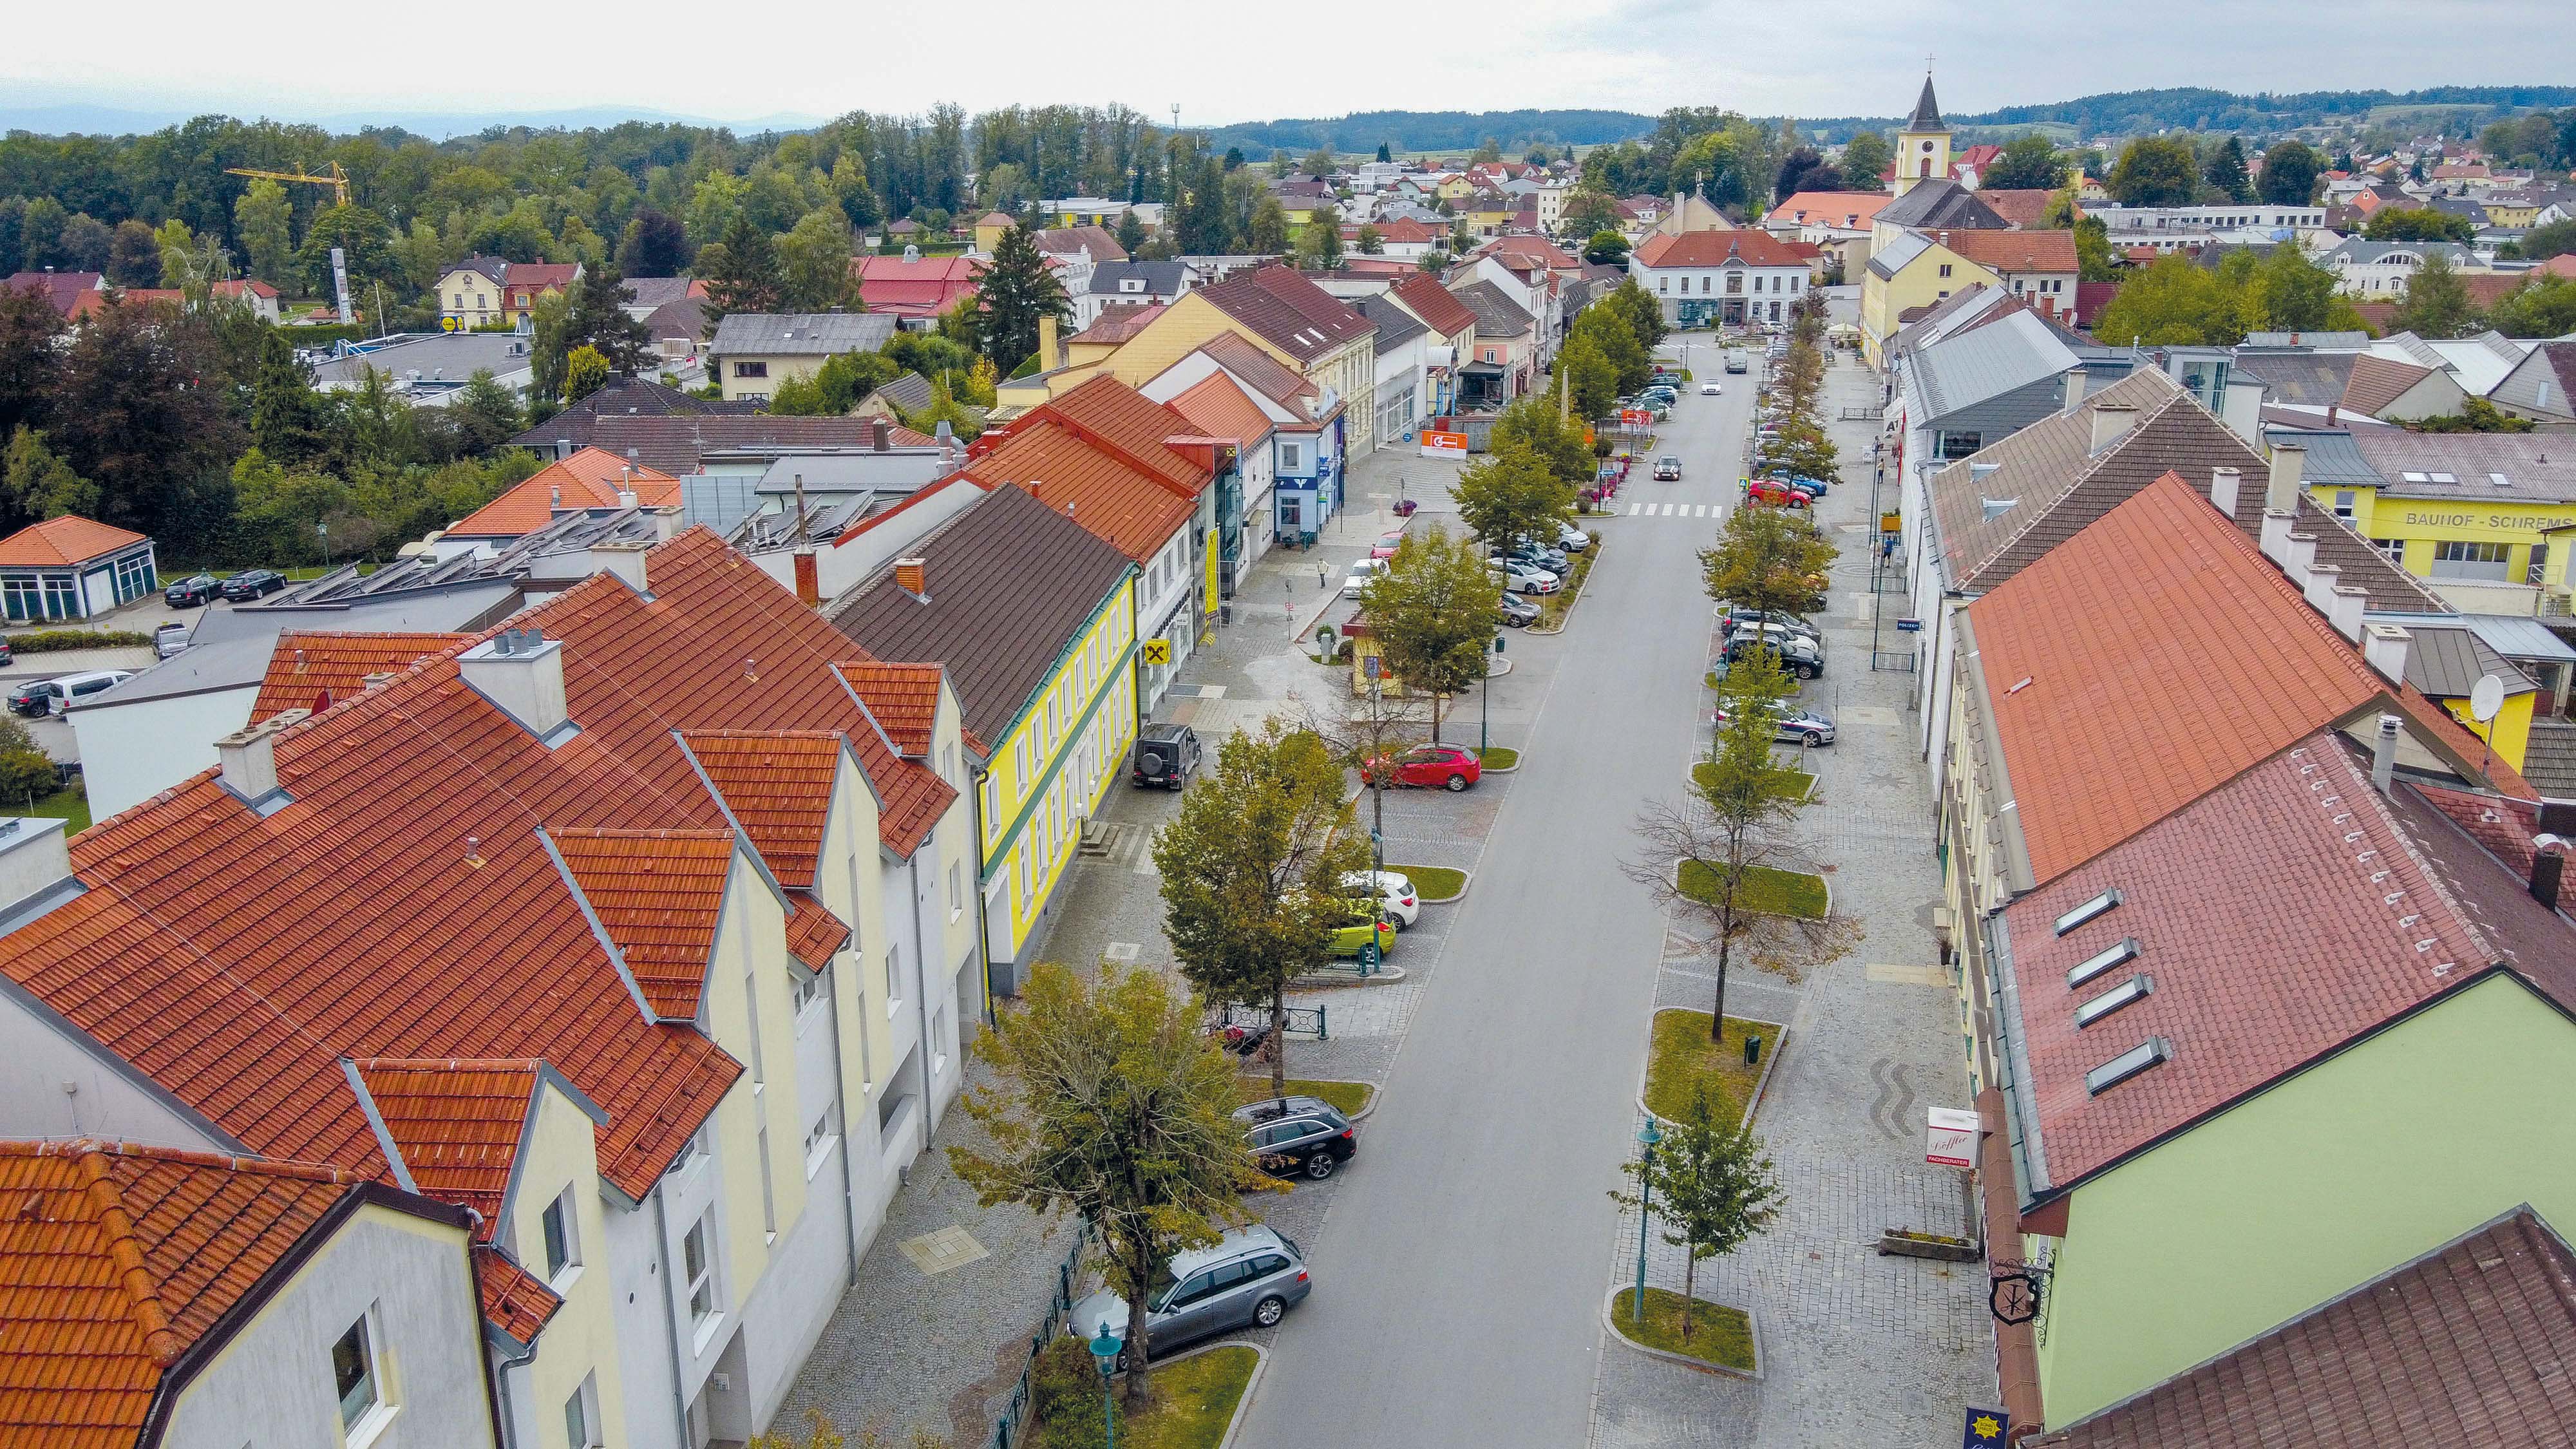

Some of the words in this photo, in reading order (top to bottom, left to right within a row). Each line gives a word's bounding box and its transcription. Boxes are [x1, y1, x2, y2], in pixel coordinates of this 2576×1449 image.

[1886, 420, 1899, 431] A1
[2406, 513, 2475, 527] BAUHOF
[2488, 515, 2573, 529] SCHREMS
[1928, 1156, 1968, 1165] FACHBERATER
